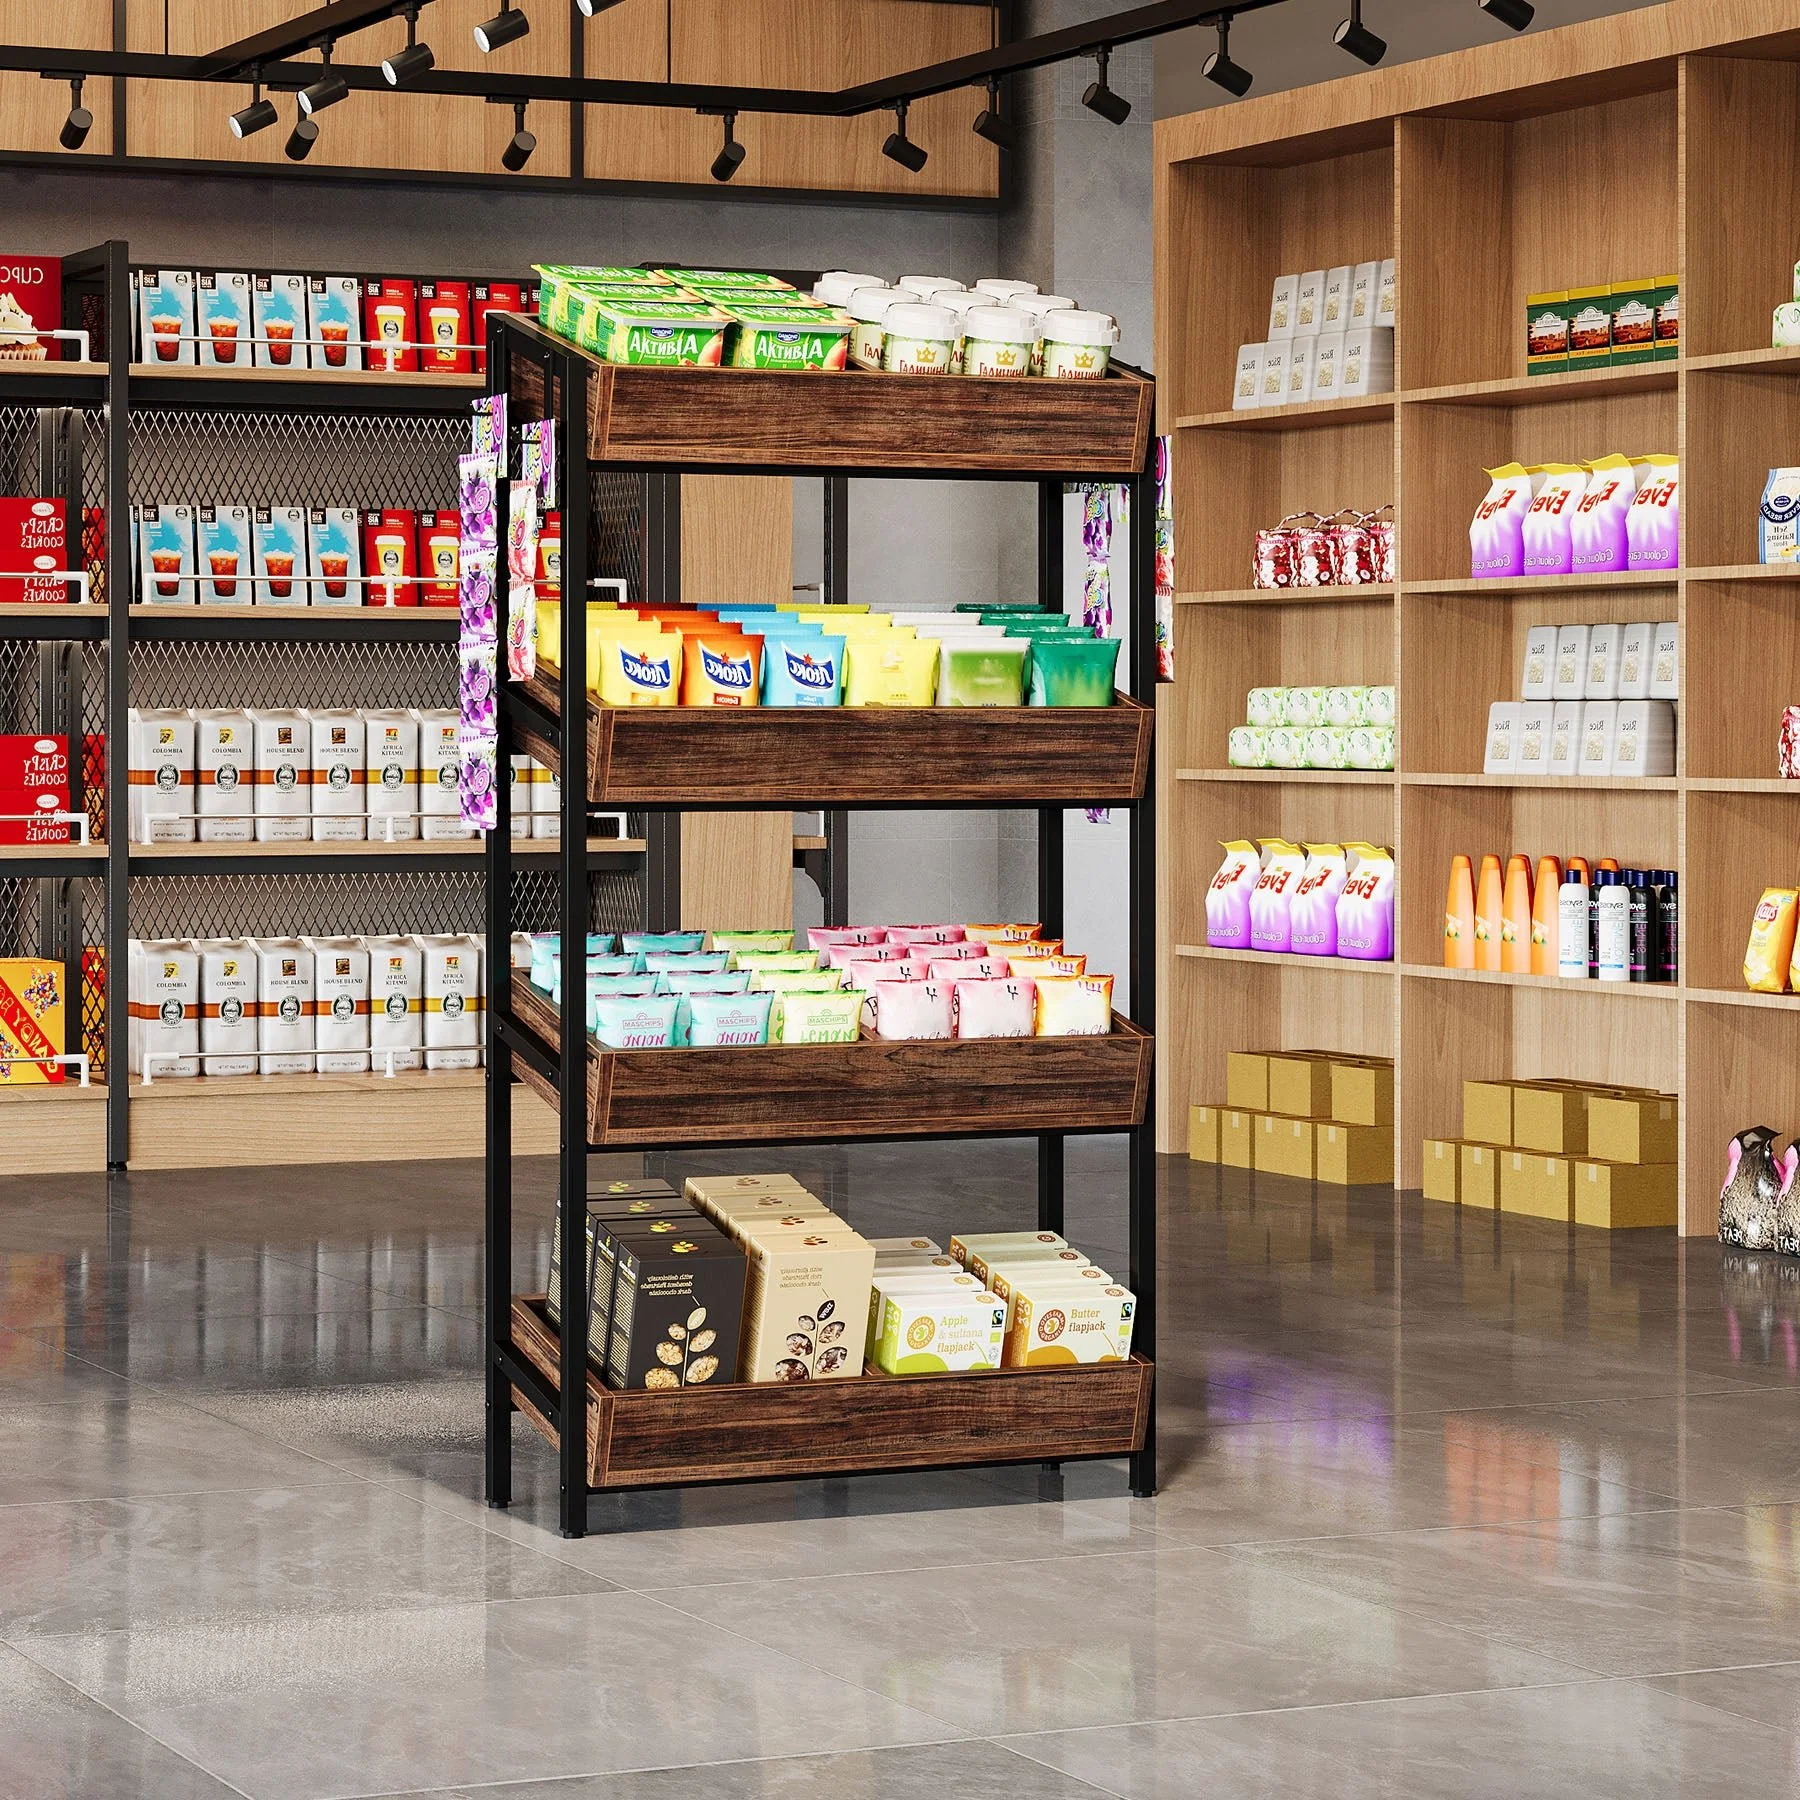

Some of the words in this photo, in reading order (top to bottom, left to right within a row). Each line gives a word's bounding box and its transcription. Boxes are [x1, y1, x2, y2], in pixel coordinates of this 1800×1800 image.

[624, 1020, 662, 1028] MASCHIPS
[1071, 1308, 1101, 1319] Butter
[940, 1316, 968, 1328] Apple
[1068, 1320, 1106, 1334] flapjack
[937, 1340, 976, 1354] flapjack
